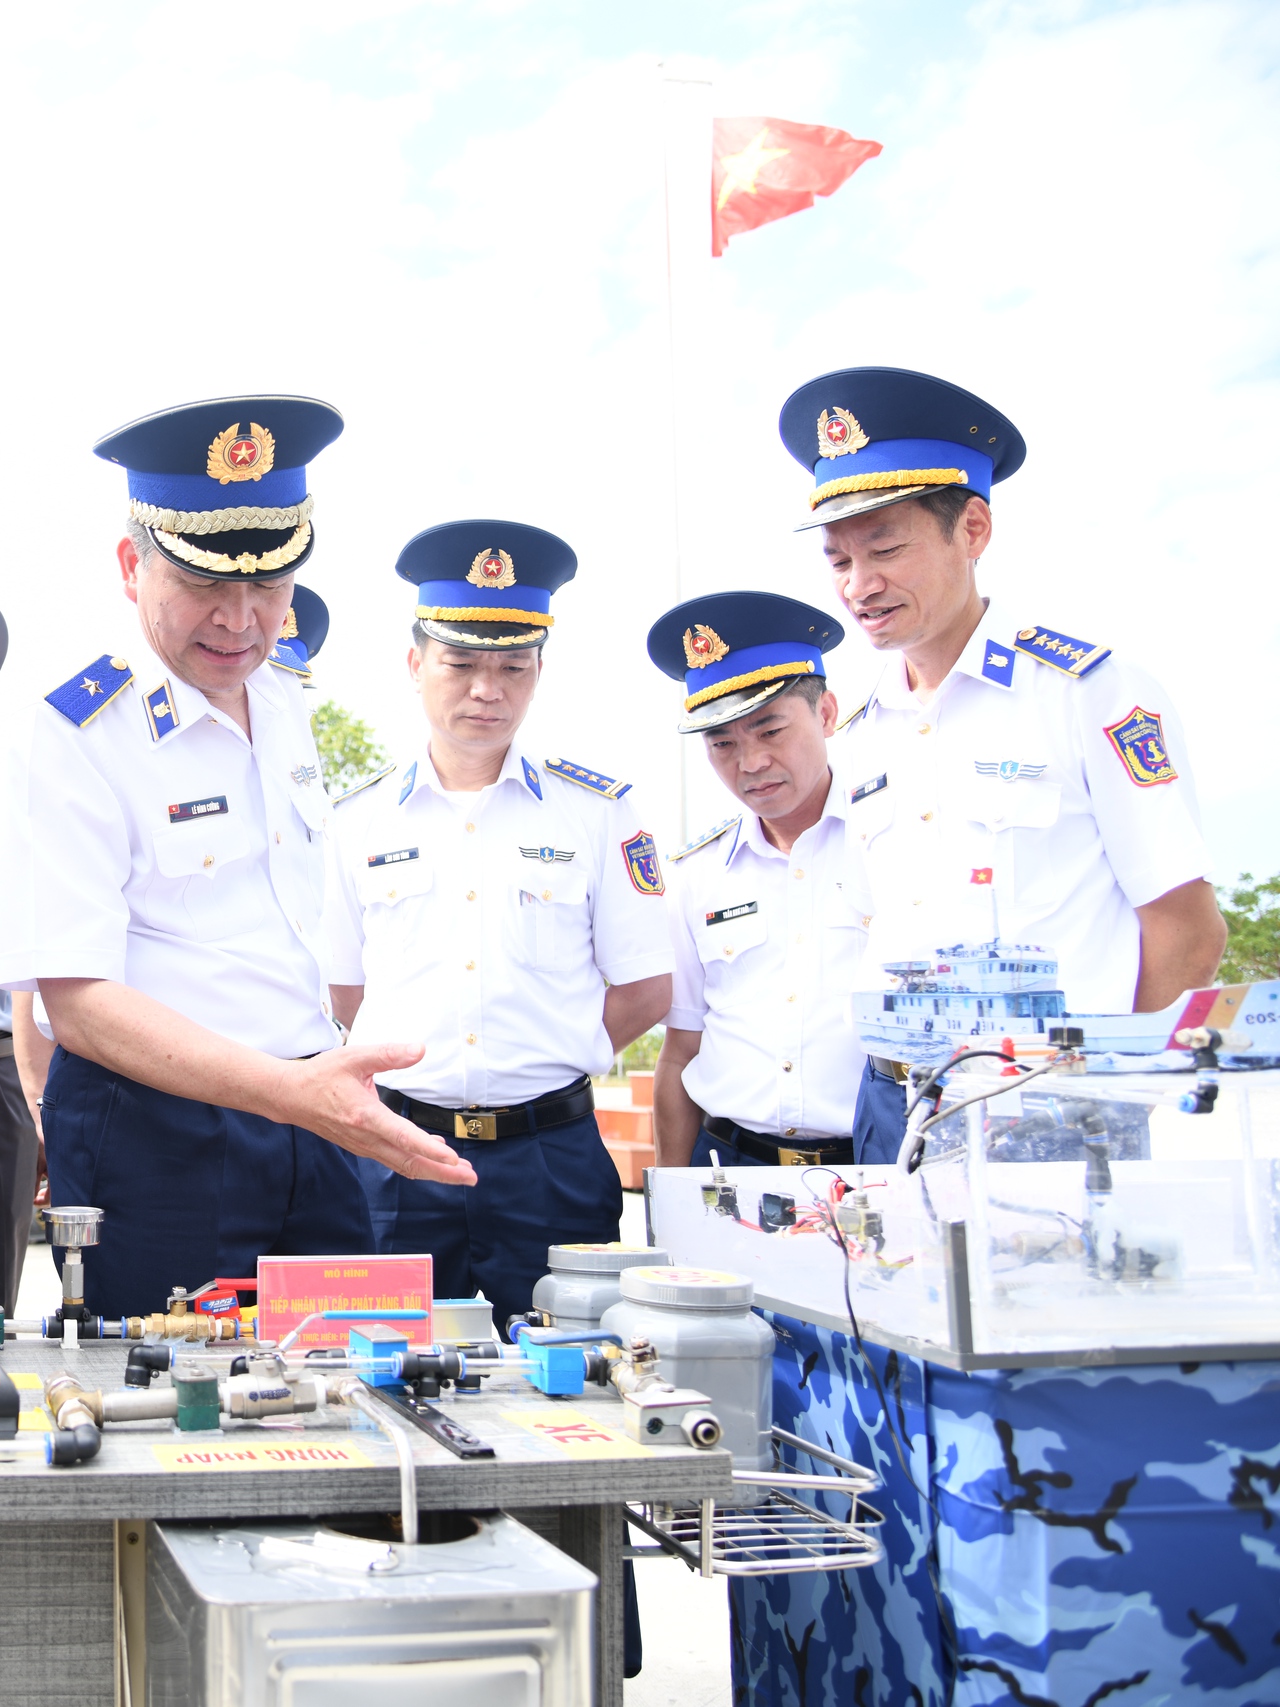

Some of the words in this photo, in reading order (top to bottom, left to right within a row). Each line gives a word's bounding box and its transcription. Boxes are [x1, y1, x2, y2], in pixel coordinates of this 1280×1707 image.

[324, 1268, 341, 1278] MÔ
[343, 1267, 369, 1278] HÌNH
[269, 1294, 289, 1314] TIẾP
[291, 1295, 316, 1317] NHẬN
[317, 1296, 329, 1312] VÀ
[332, 1292, 349, 1311] CẤP
[351, 1294, 373, 1311] PHÁT
[302, 1332, 320, 1343] THỰC
[533, 1423, 615, 1444] XE
